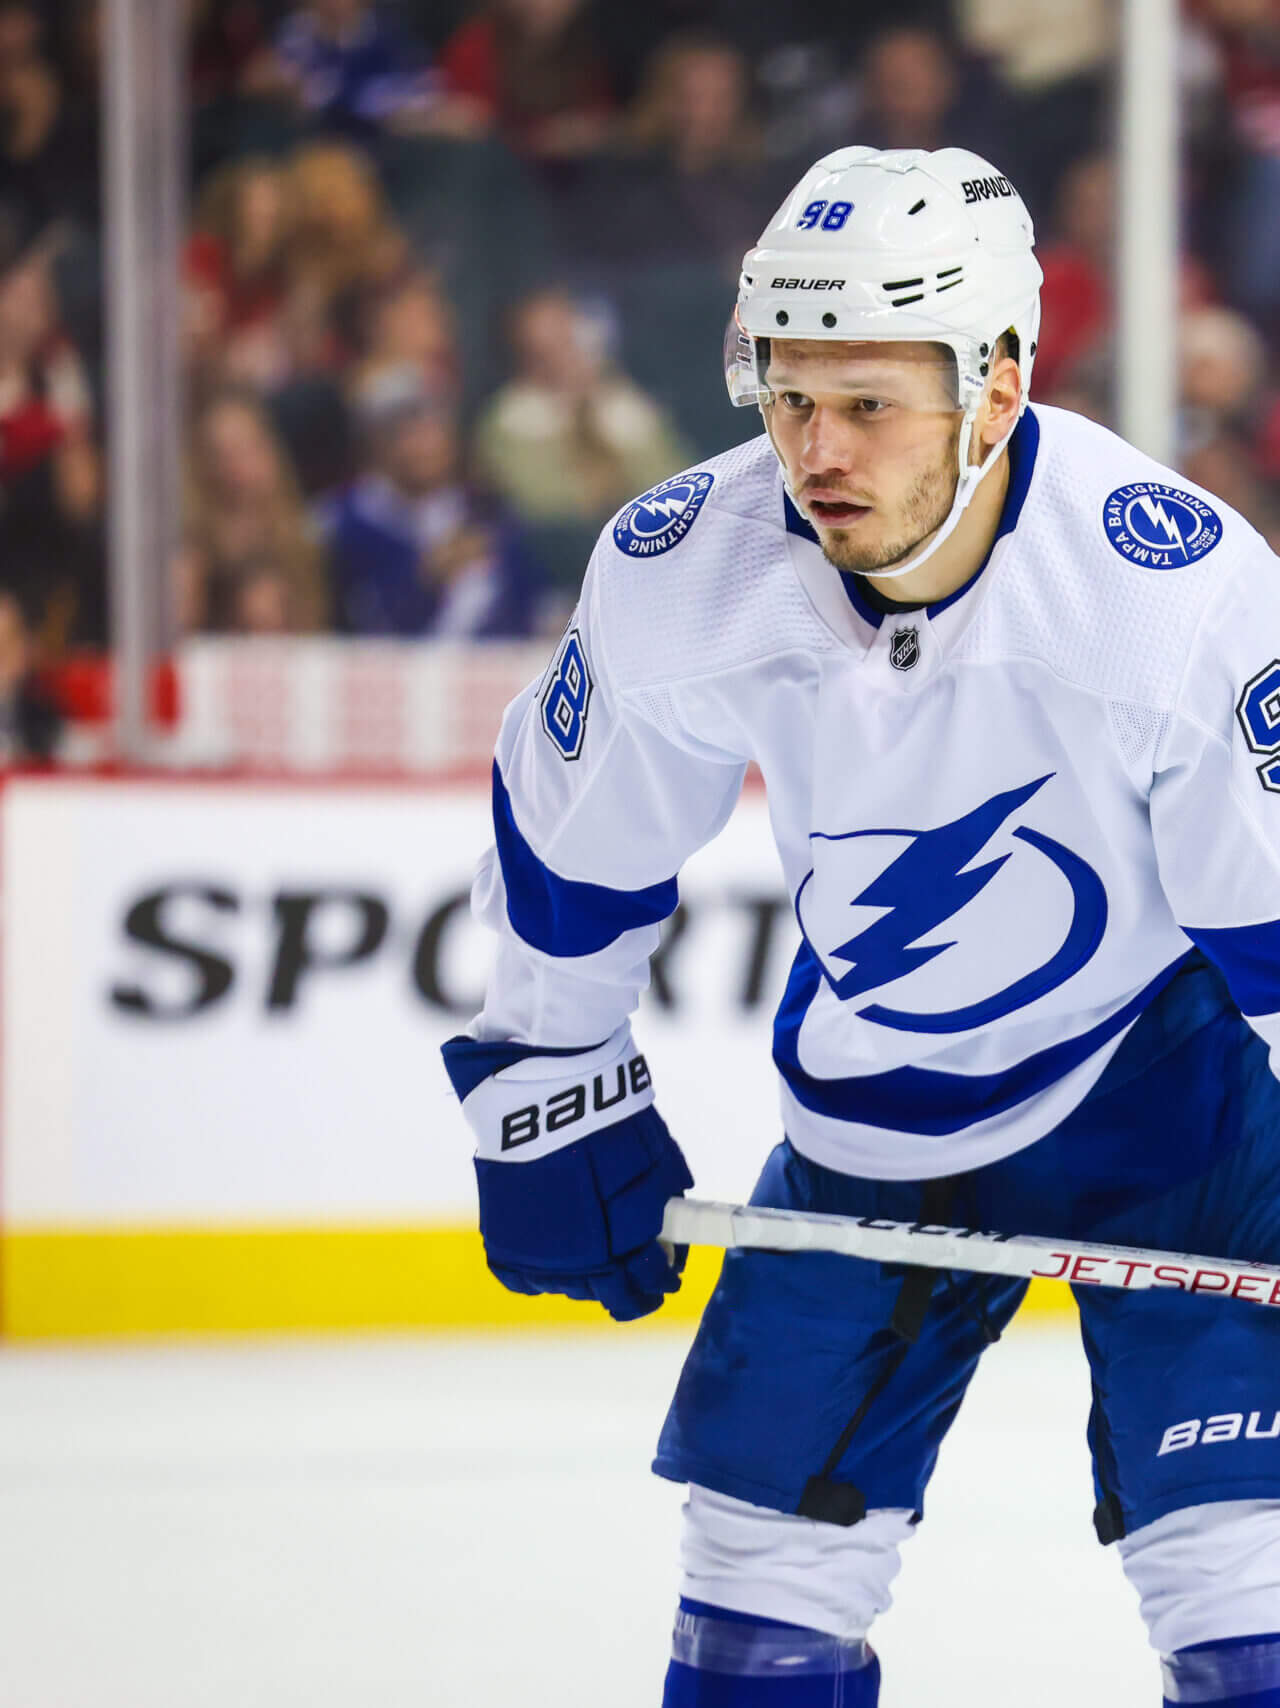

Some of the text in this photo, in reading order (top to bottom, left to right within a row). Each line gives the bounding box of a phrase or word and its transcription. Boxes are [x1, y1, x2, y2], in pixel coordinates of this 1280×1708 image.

[796, 200, 854, 231] 98
[770, 278, 846, 291] BAUER
[628, 494, 704, 554] LIGHTNING
[1108, 483, 1213, 565] TAMPA BAY LIGHTNING
[895, 638, 915, 664] NHL
[535, 615, 594, 761] 8
